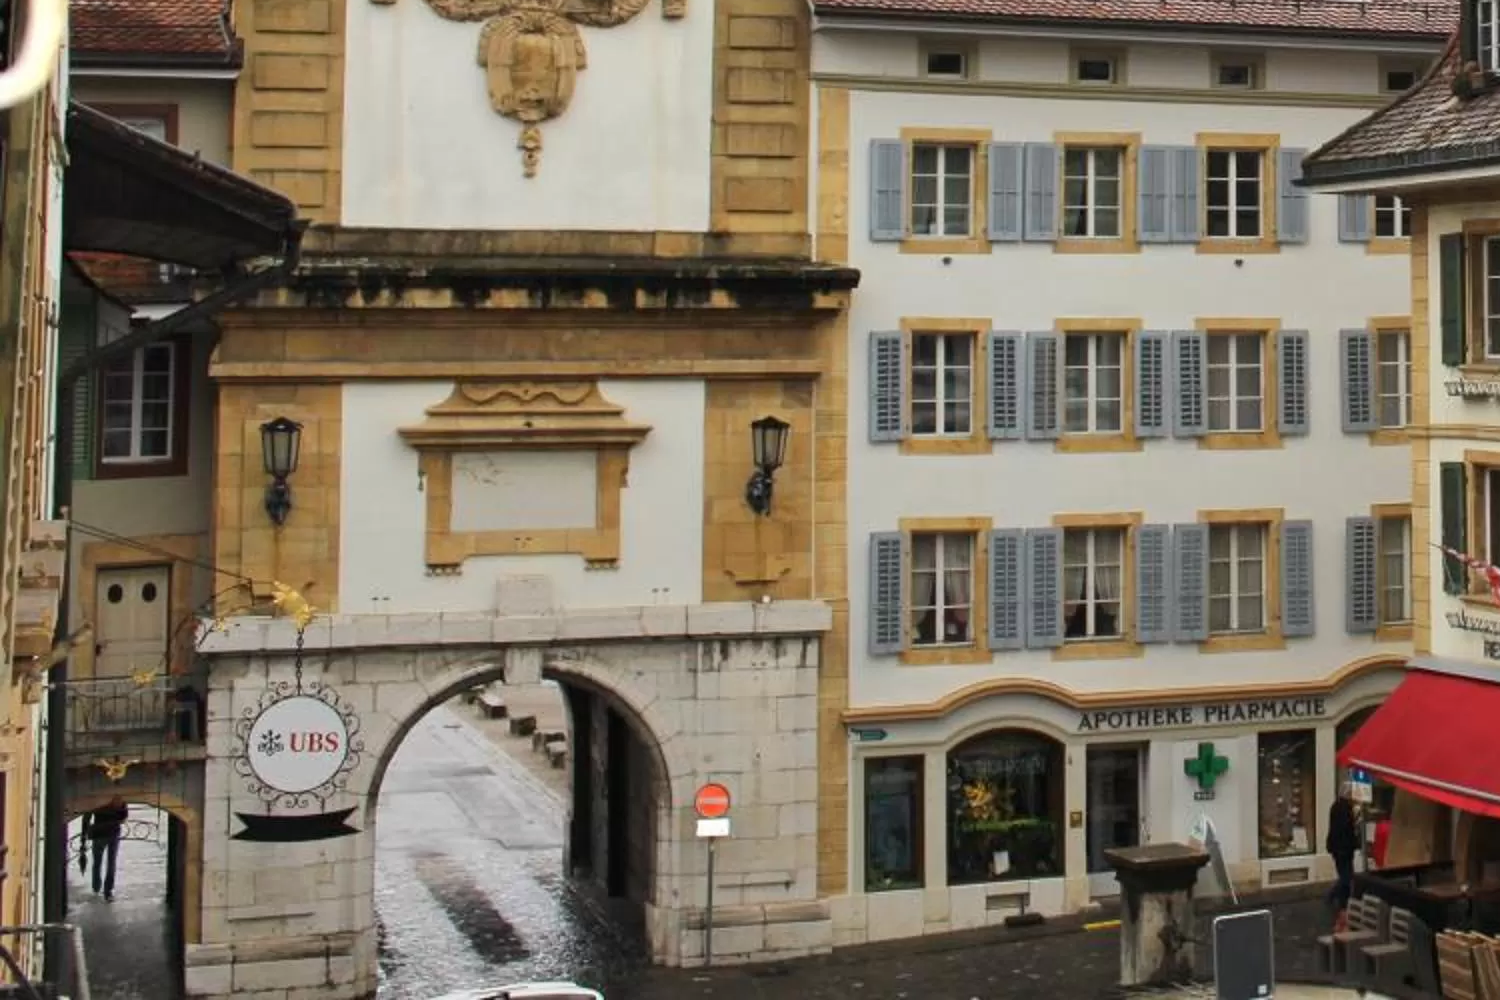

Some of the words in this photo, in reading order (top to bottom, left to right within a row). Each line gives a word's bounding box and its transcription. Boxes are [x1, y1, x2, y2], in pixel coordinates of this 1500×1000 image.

[1077, 706, 1193, 731] APOTHEKE
[1204, 698, 1327, 723] PHARMACIE
[289, 731, 339, 753] UBS
